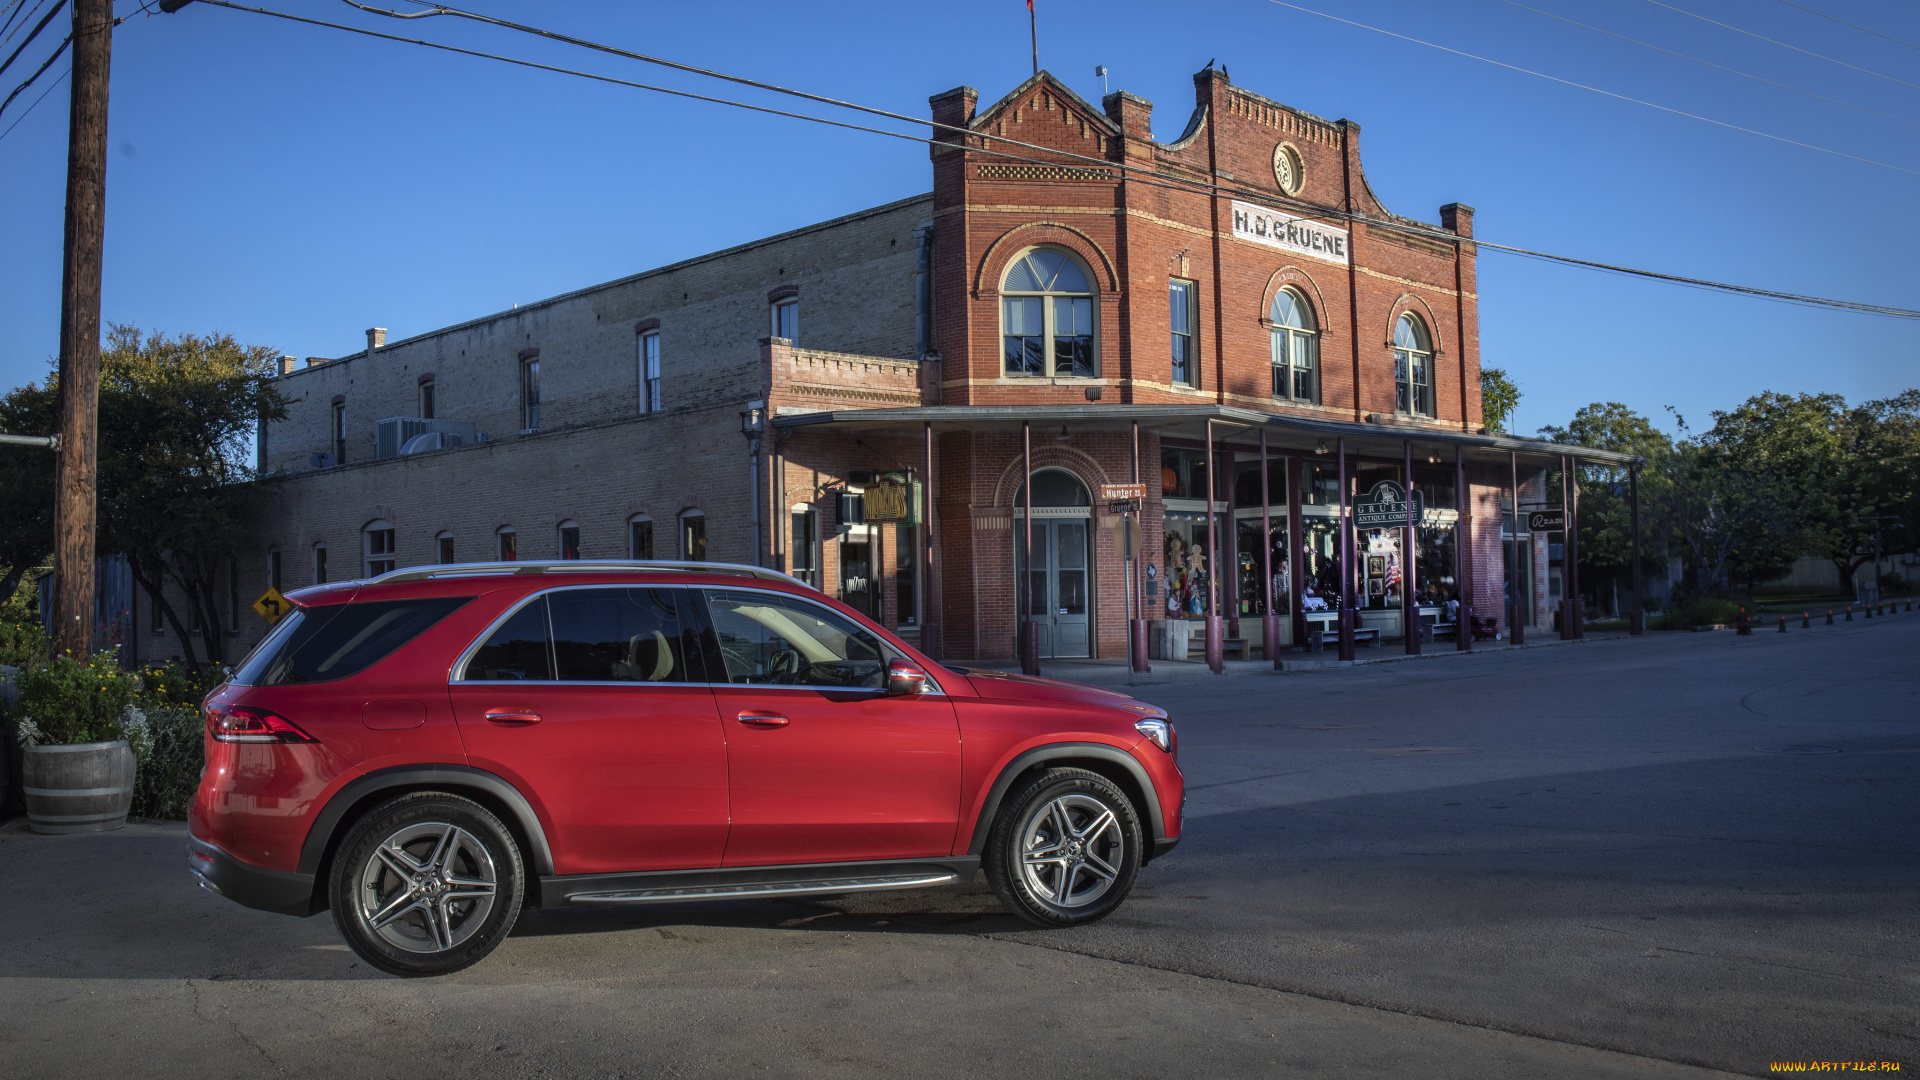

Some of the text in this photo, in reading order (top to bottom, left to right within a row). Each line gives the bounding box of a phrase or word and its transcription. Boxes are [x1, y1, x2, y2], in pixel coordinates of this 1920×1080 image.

[1106, 489, 1132, 498] Hunter
[1357, 502, 1418, 514] GRUENE
[1358, 513, 1387, 522] ANTIQUE
